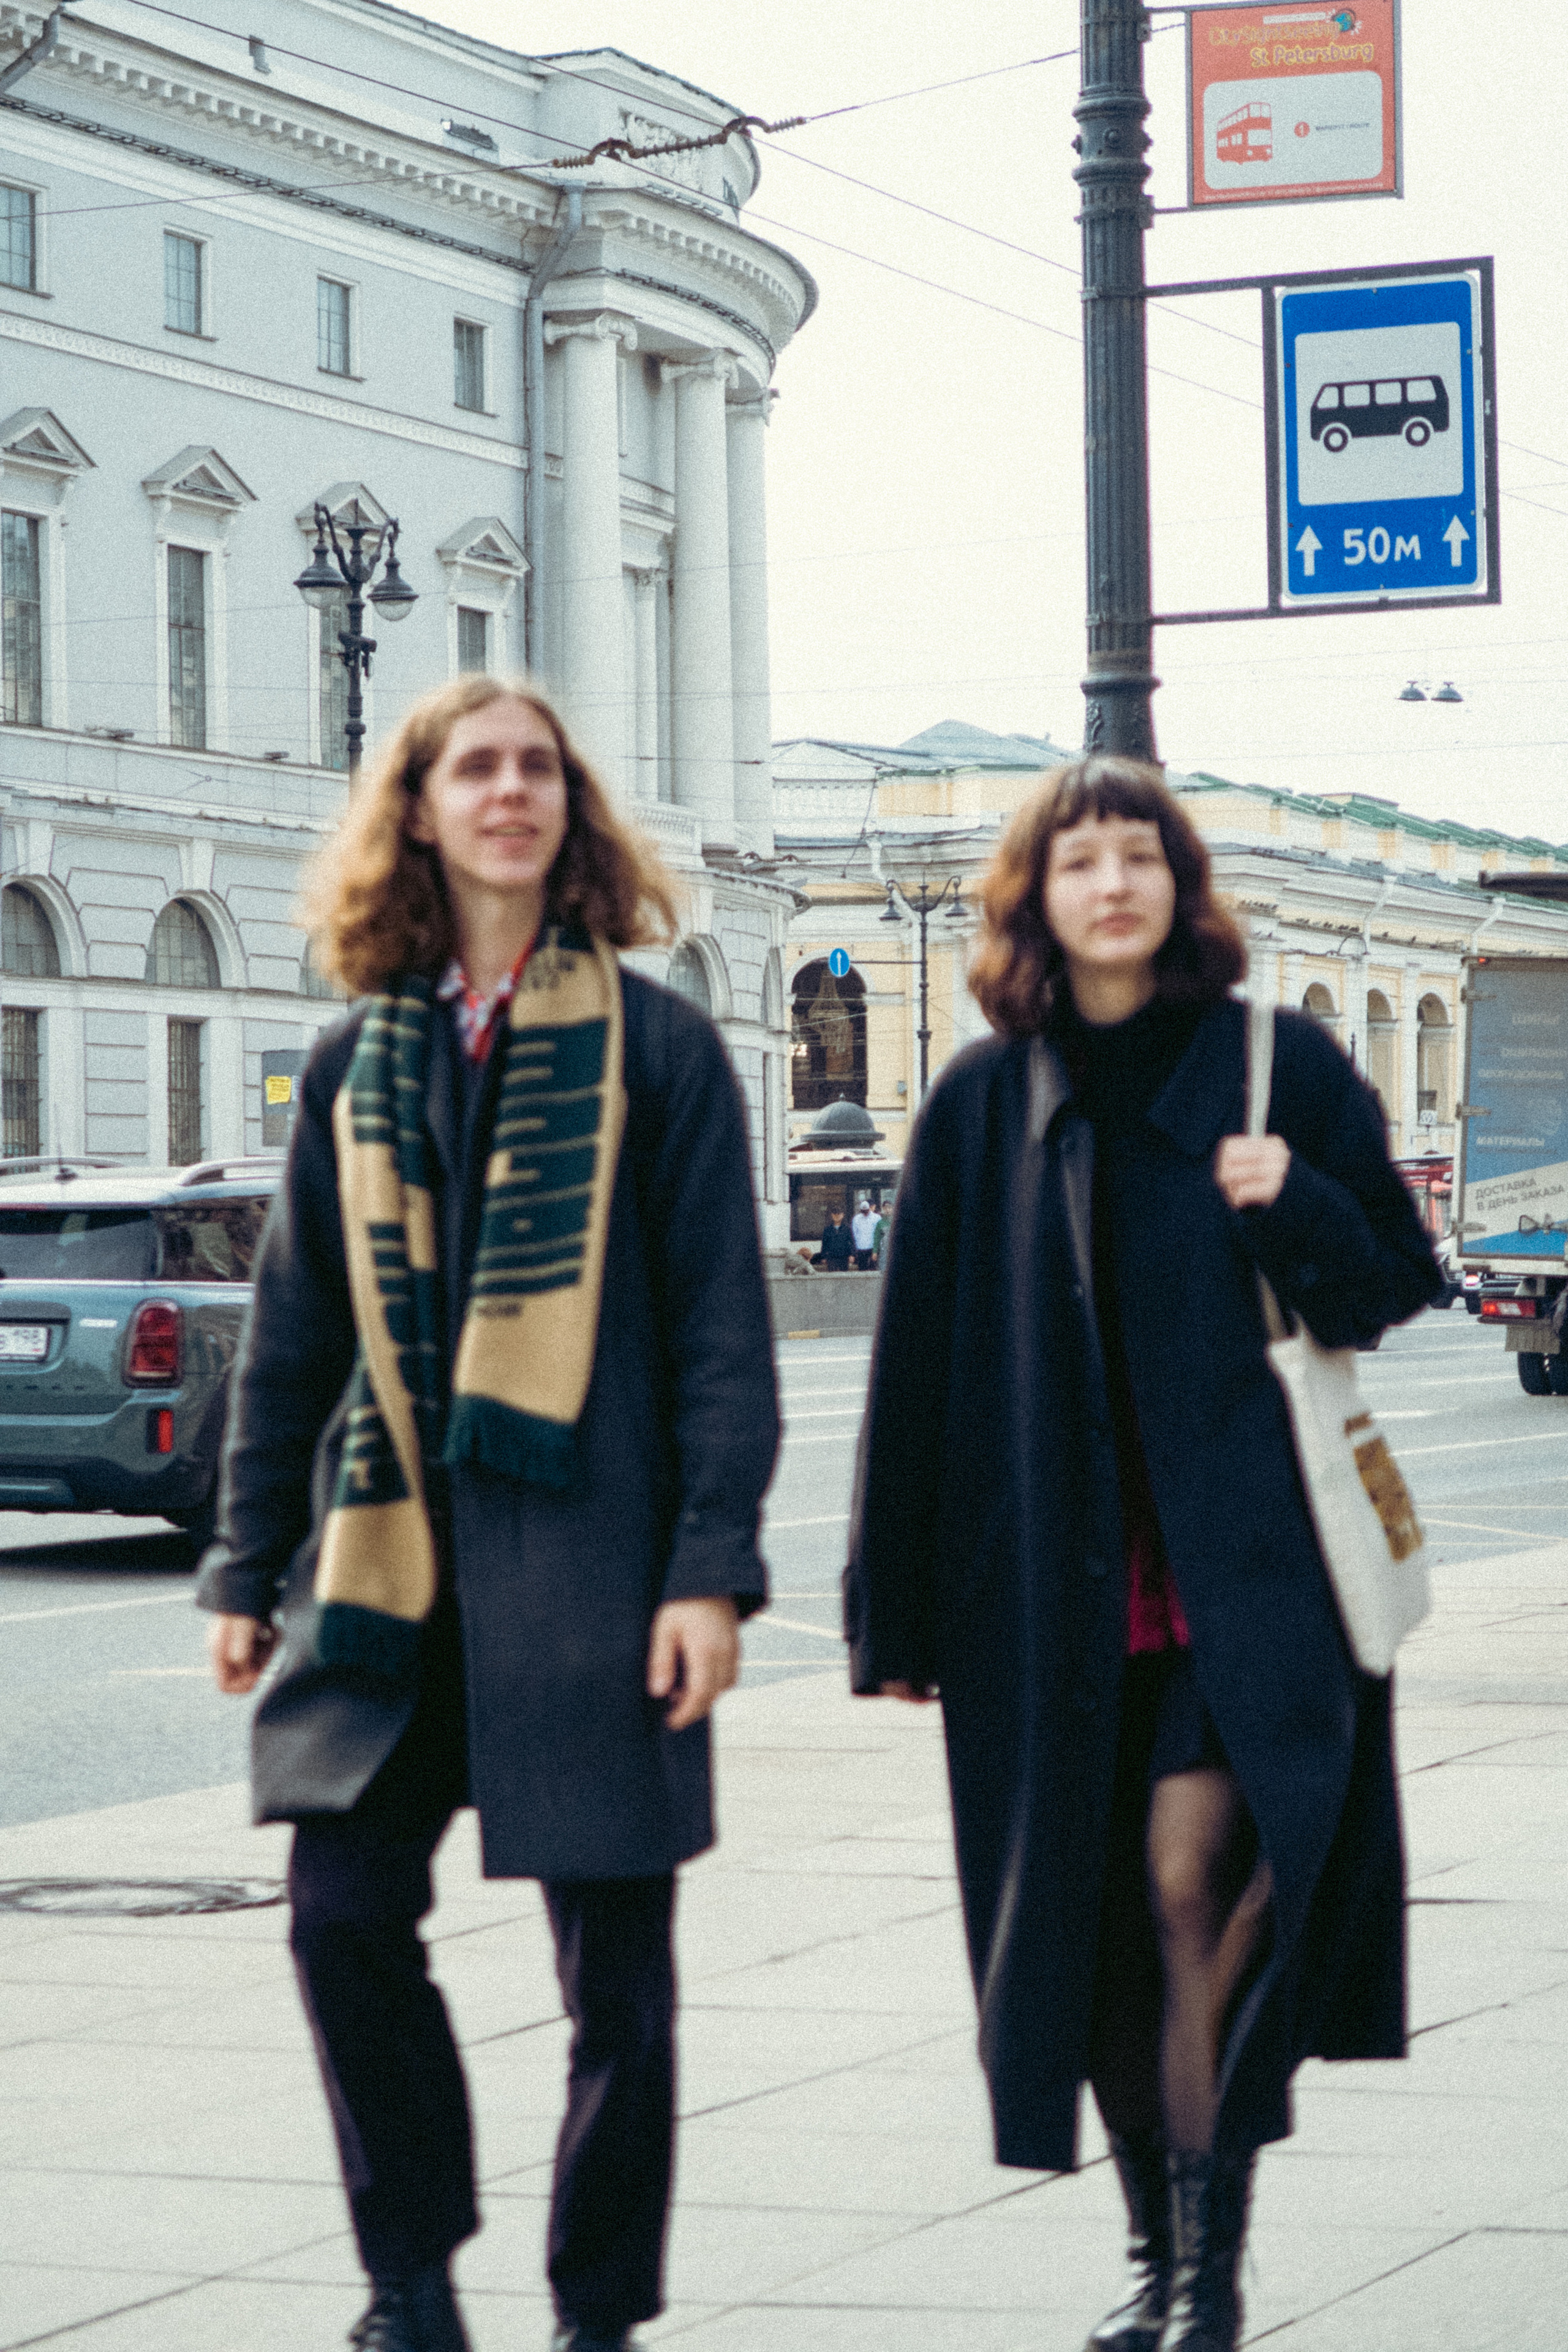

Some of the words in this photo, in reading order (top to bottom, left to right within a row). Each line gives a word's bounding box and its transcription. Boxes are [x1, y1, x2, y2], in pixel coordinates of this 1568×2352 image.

[1250, 47, 1270, 67] St
[1273, 42, 1374, 65] Petersburg
[1476, 1136, 1545, 1147] МАТЕРИАЛЫ
[1476, 1177, 1536, 1199] ДОСТАВКА
[1477, 1202, 1484, 1211] В
[1488, 1196, 1518, 1211] ДЕНЬ
[1521, 1185, 1565, 1202] ЗАКАЗА
